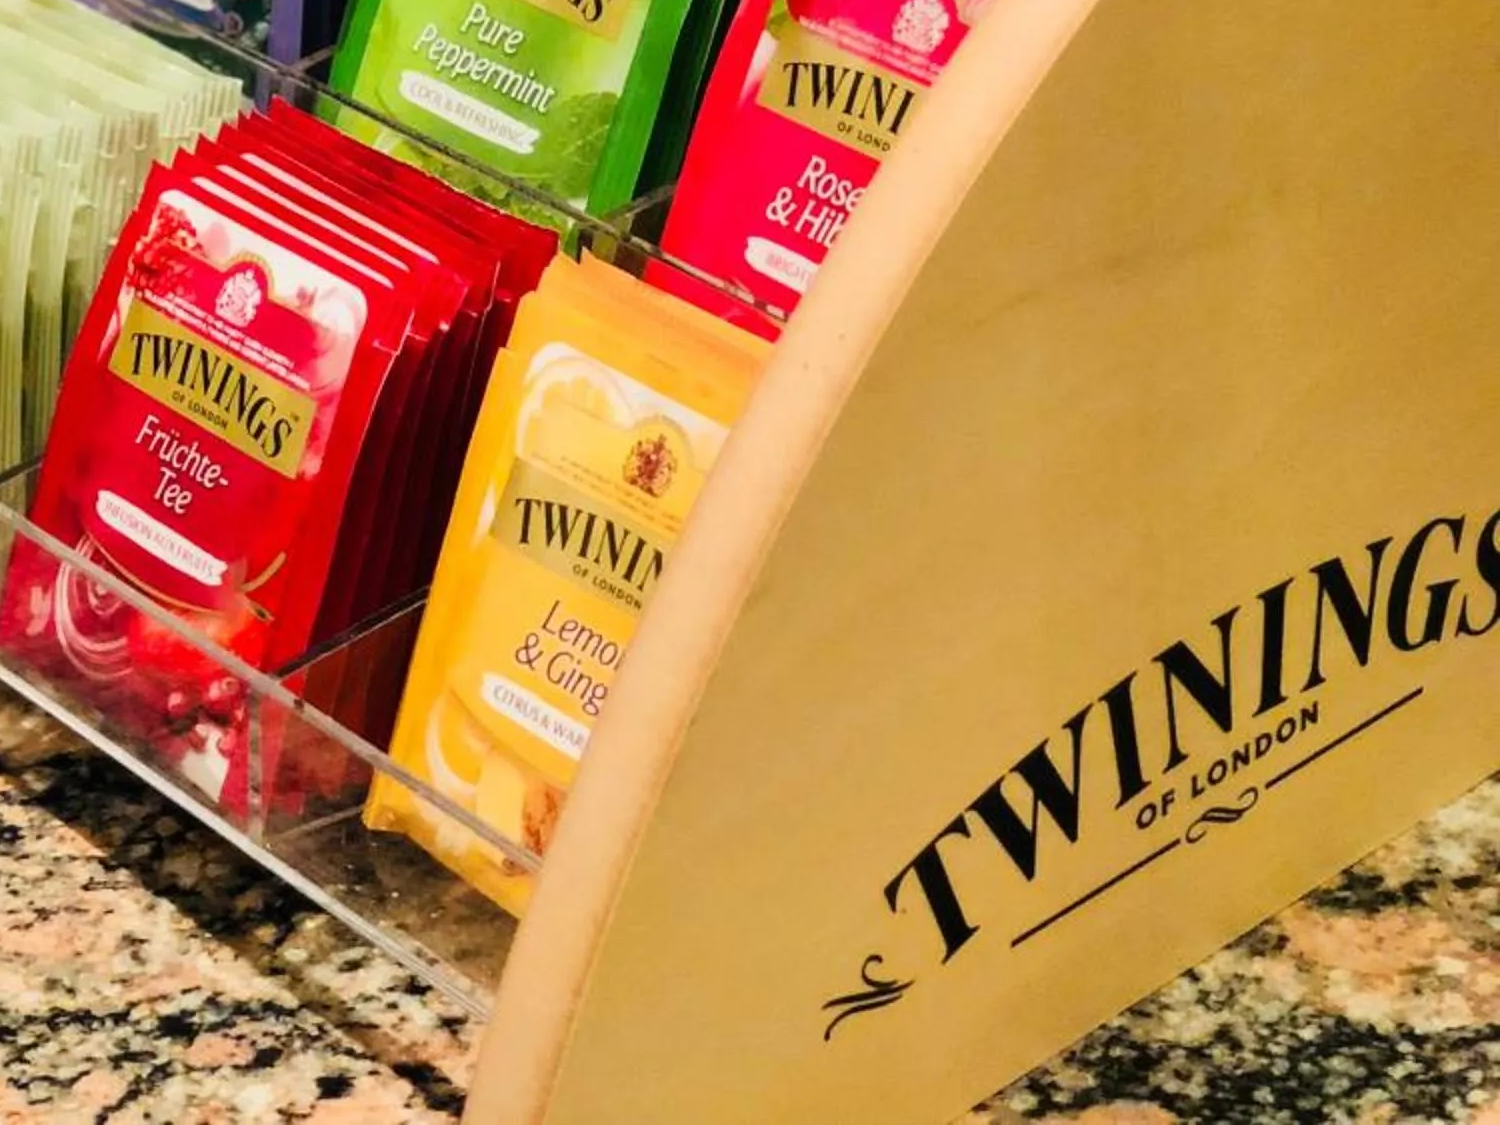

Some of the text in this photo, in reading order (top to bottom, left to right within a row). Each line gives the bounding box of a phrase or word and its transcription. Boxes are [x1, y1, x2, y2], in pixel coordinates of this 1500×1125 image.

[460, 1, 525, 55] Pure
[412, 22, 556, 114] Peppermint
[836, 121, 854, 134] OF
[765, 186, 798, 227] &
[131, 331, 293, 458] TWININGS
[171, 390, 229, 430] OF LONDON
[134, 414, 229, 489] Früchte-
[152, 466, 193, 515] Tee
[572, 563, 643, 611] OF LONDON
[514, 631, 545, 672] &
[492, 682, 543, 726] CITRUS
[883, 508, 1500, 964] TWININGS
[1135, 701, 1320, 831] OF LONDON
